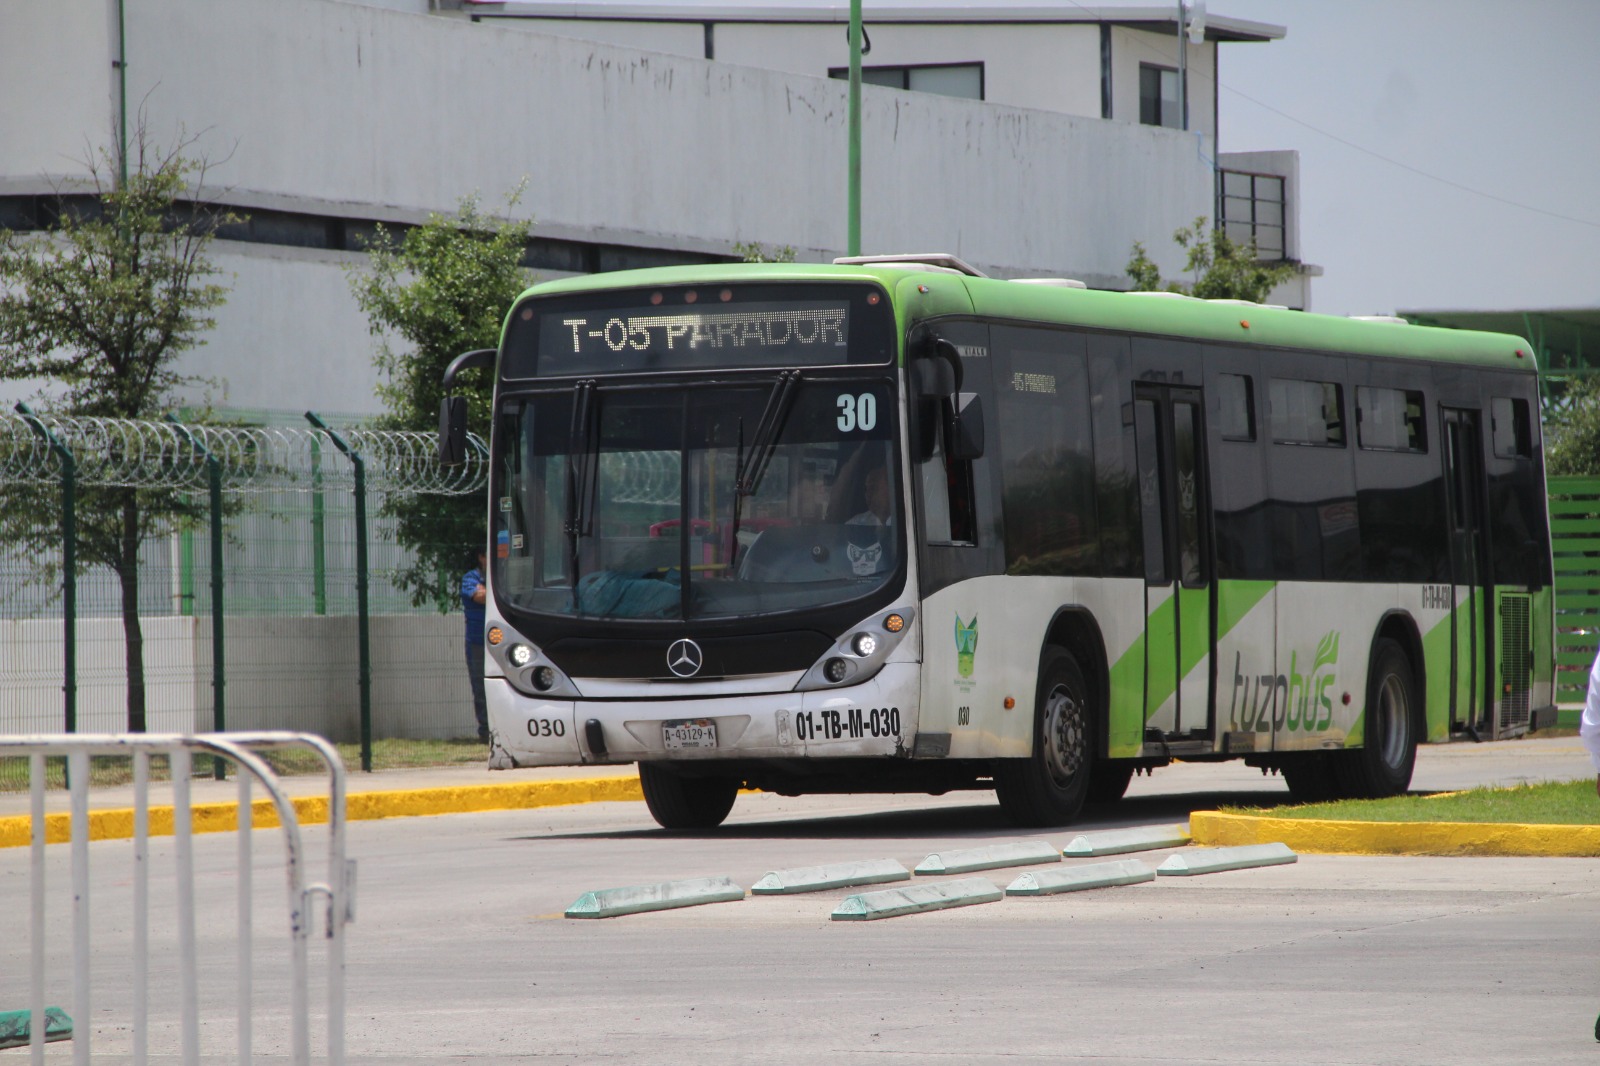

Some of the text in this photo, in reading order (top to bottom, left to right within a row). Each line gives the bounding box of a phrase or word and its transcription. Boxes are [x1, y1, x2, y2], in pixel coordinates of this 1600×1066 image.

[563, 308, 846, 352] T-05 PARADOR
[836, 392, 877, 433] 30
[1230, 649, 1336, 732] tuzobus
[526, 718, 566, 738] 030
[795, 706, 901, 741] 01-TB-M-030
[957, 706, 970, 726] 030
[664, 727, 714, 742] A-43129-K
